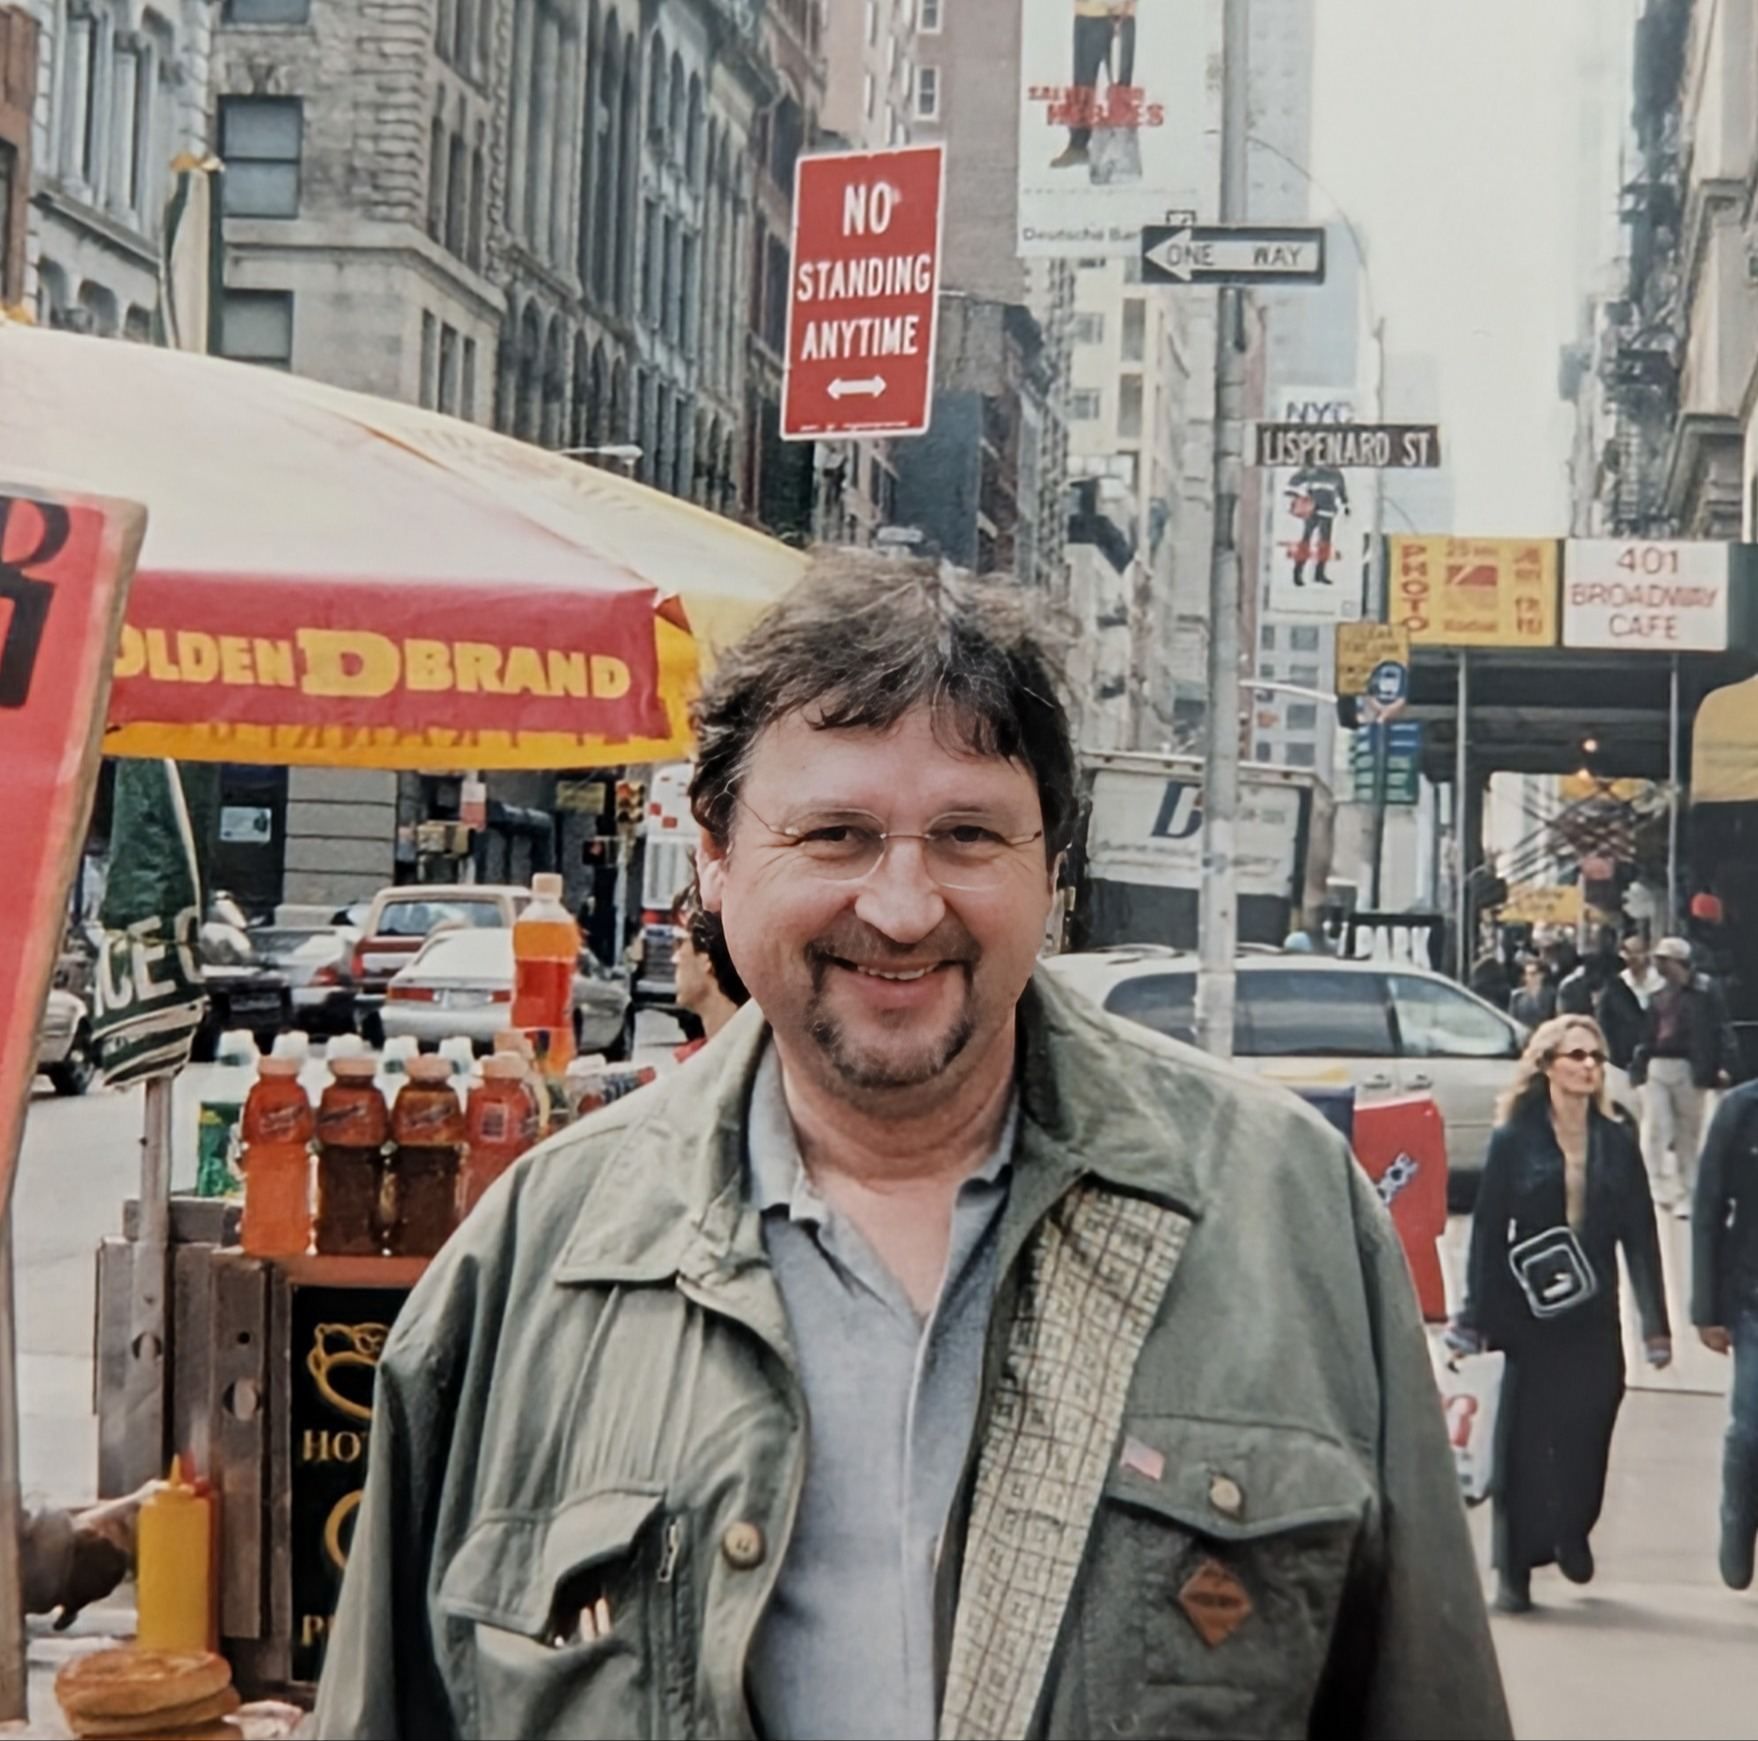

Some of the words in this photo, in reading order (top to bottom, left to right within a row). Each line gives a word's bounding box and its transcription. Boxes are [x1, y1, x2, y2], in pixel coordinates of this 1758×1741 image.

[843, 181, 893, 236] NO
[1166, 244, 1215, 267] ONE
[1252, 246, 1302, 265] WAY
[797, 254, 931, 301] STANDING
[801, 315, 919, 361] ANYTIME
[1263, 430, 1390, 466] LISPENARD
[1402, 432, 1431, 466] ST
[1617, 547, 1678, 574] 401
[1402, 544, 1430, 632] PHOTO
[1571, 583, 1717, 607] BROADWAY
[1609, 614, 1677, 639] CAFE
[403, 638, 631, 699] BRAND
[303, 1429, 368, 1462] HO
[301, 1614, 335, 1647] P
